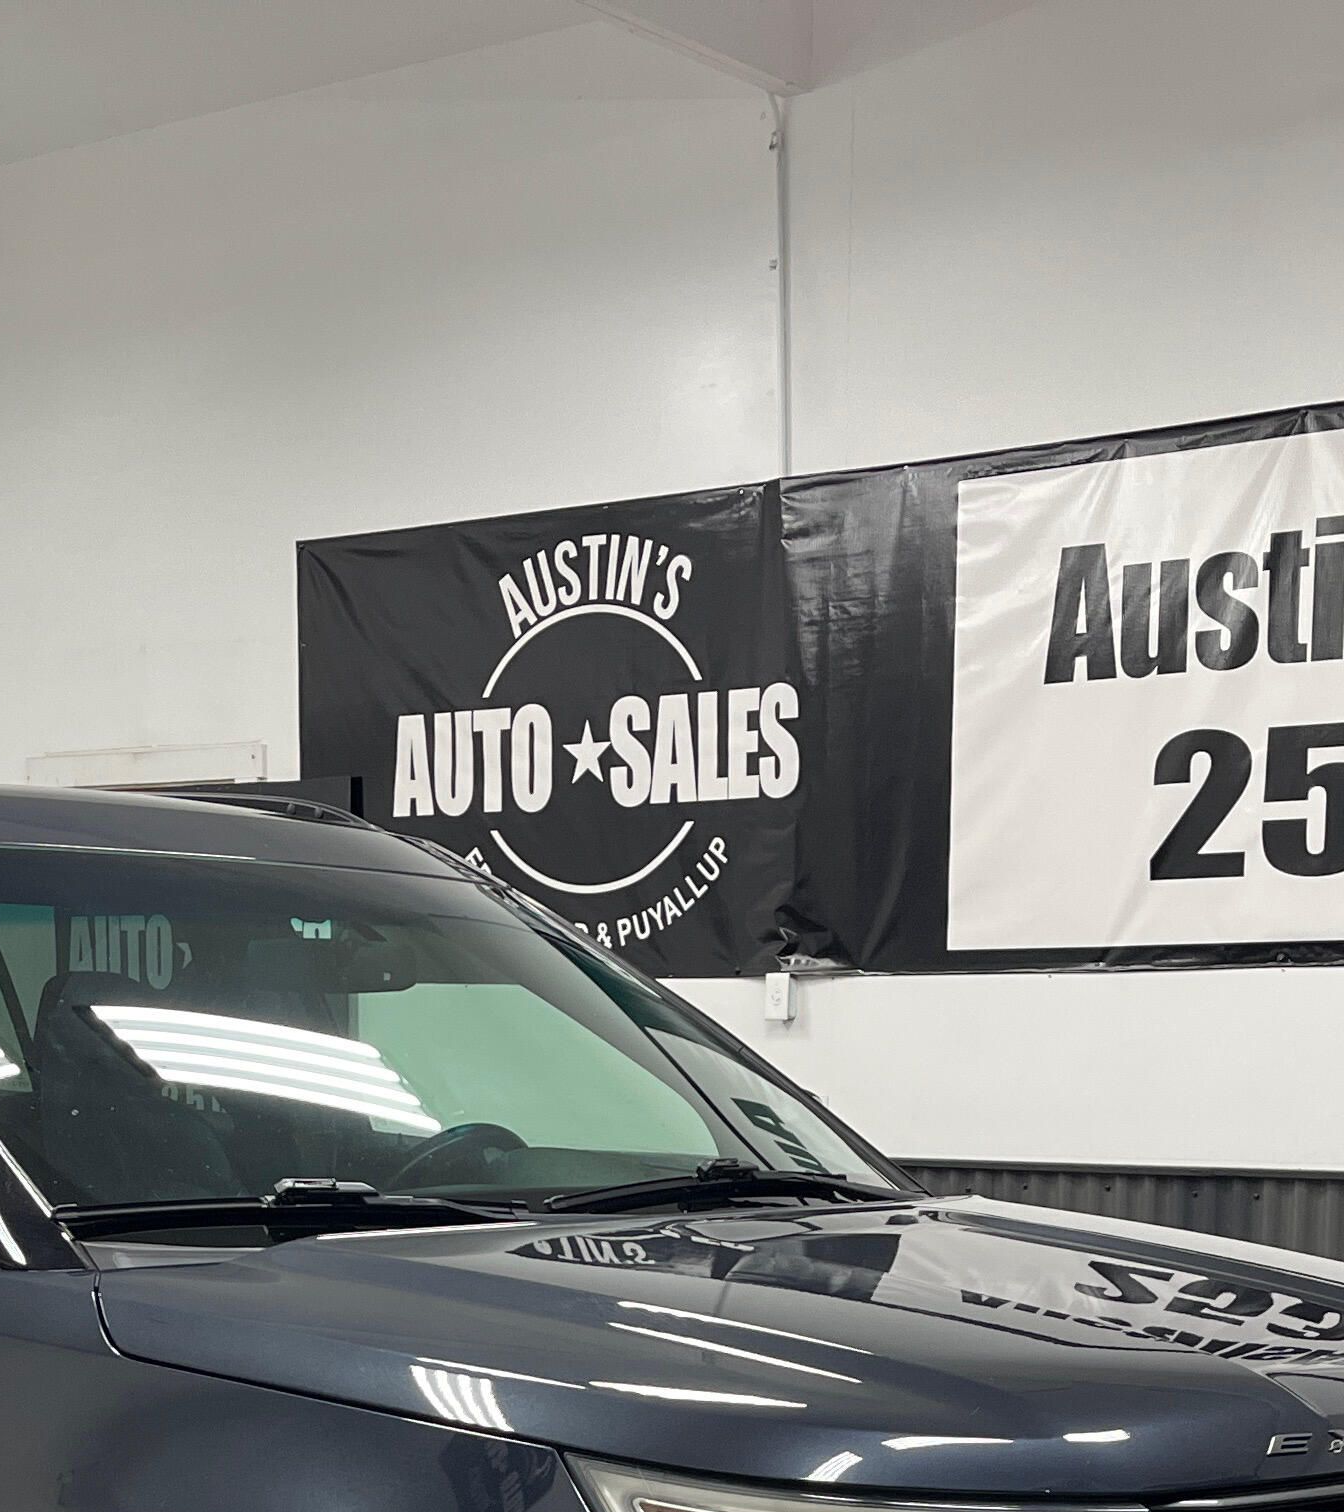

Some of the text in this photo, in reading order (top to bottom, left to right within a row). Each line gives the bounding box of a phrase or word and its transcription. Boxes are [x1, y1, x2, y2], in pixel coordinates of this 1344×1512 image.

[498, 534, 693, 638] AUSTIN'S
[392, 681, 800, 818] AUTO SALES
[616, 836, 728, 946] PUYALLUP
